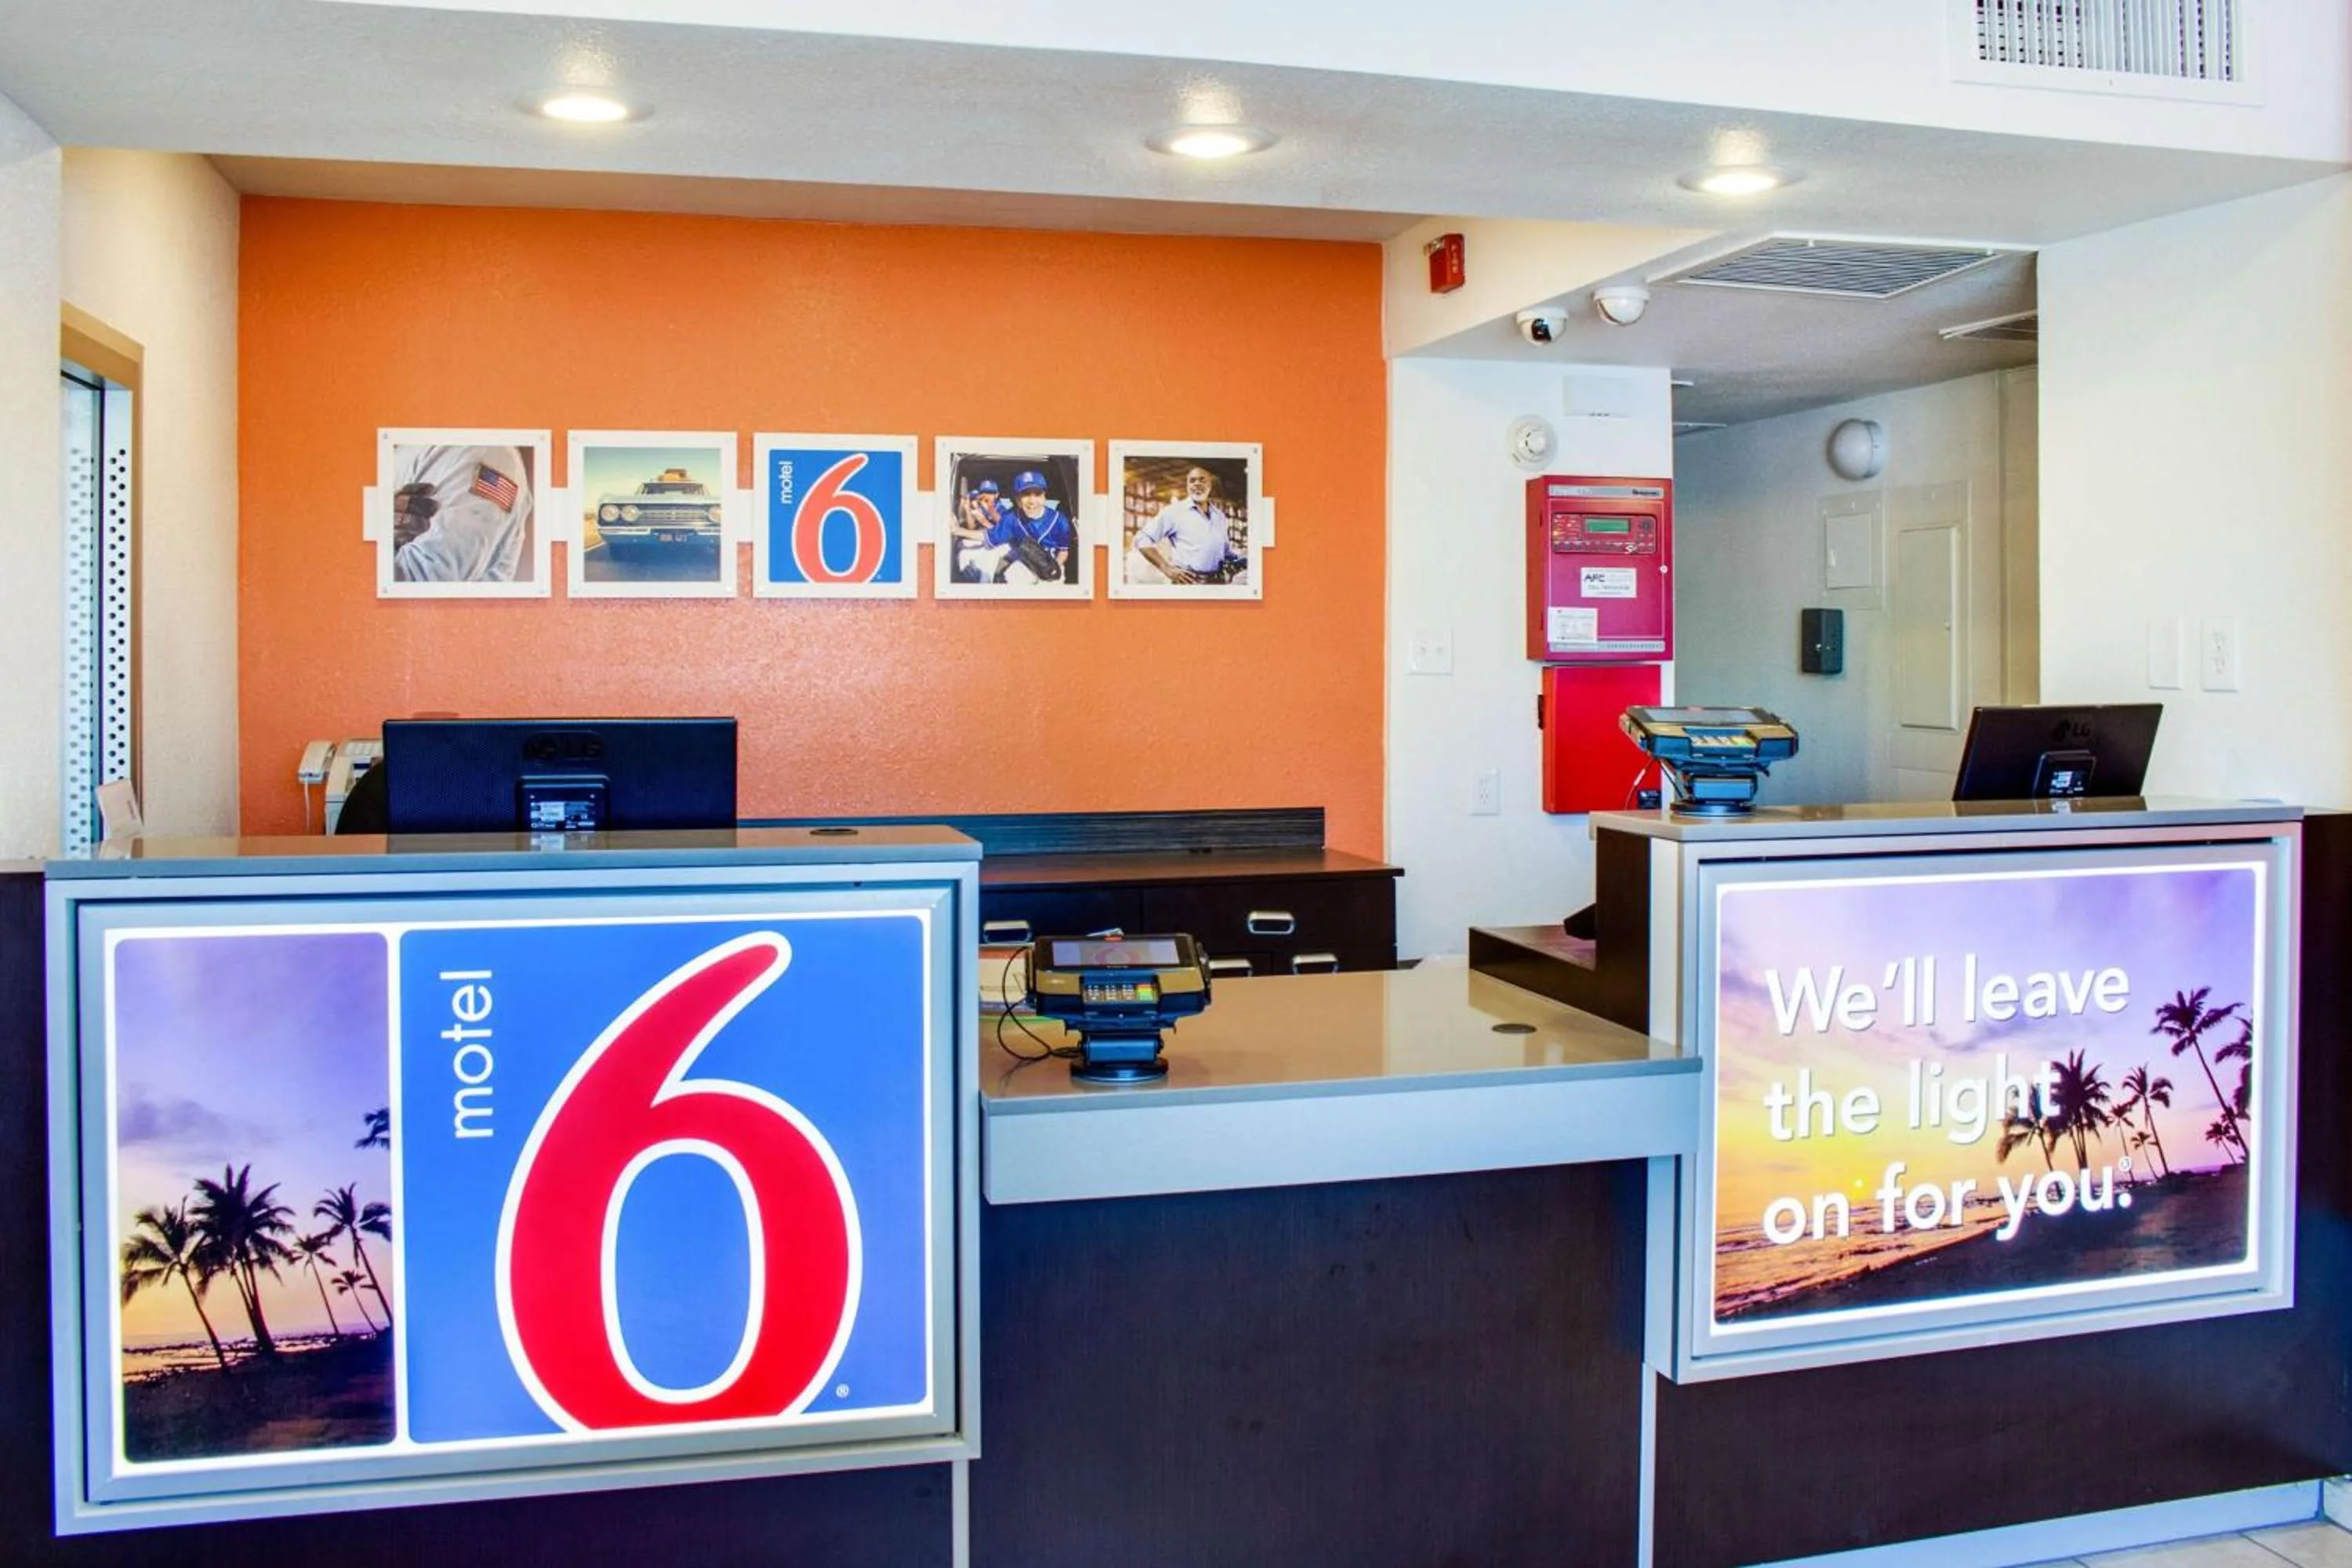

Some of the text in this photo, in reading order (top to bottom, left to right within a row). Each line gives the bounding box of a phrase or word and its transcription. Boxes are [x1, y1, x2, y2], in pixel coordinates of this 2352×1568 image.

[779, 460, 793, 504] motel
[791, 452, 886, 583] 6
[2072, 721, 2091, 737] LG
[1765, 953, 2130, 1035] We'll leave
[440, 970, 492, 1138] motel
[1764, 1054, 2061, 1144] the light
[495, 931, 862, 1432] 6
[1763, 1161, 2133, 1244] on for you.
